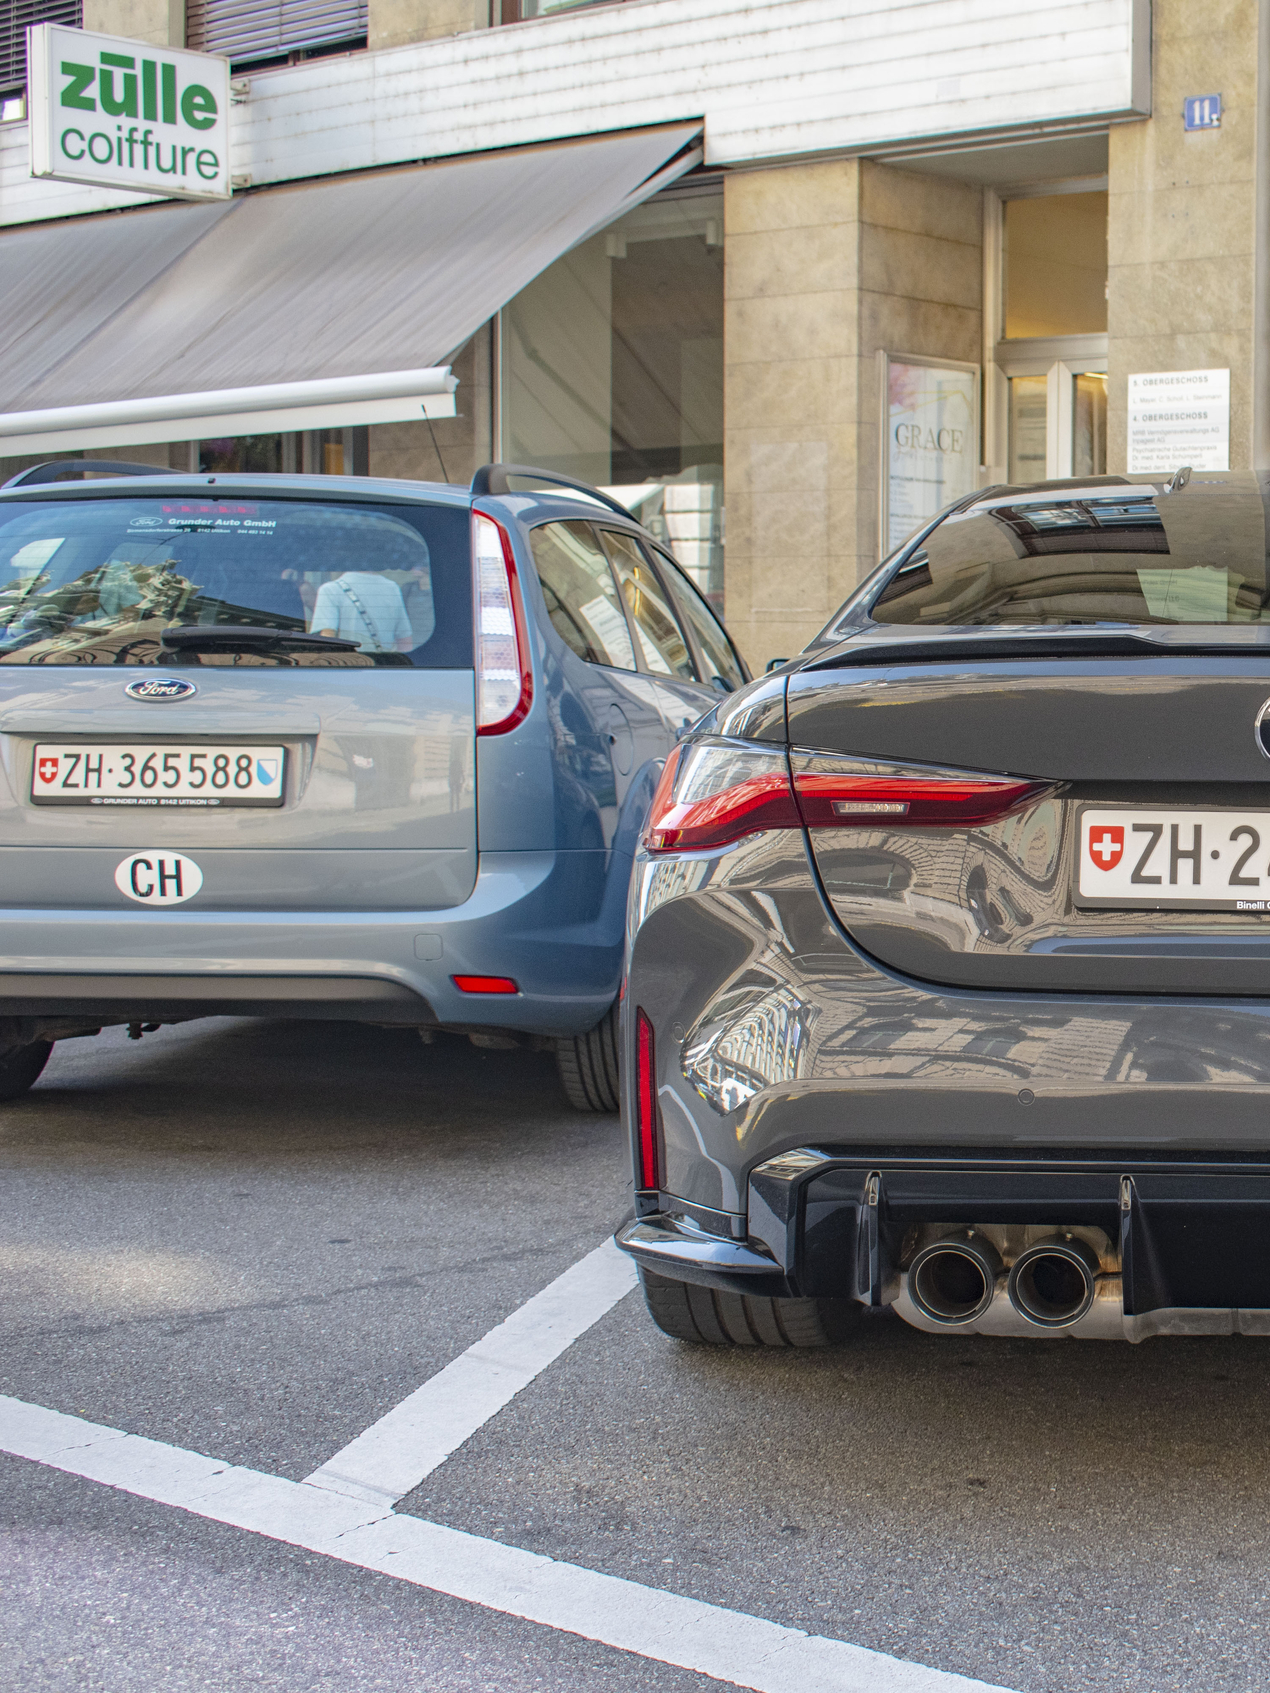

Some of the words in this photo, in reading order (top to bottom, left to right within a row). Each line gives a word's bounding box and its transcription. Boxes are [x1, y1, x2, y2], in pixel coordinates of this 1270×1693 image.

[61, 125, 219, 180] coiffure
[1143, 375, 1209, 386] OBERGESCHOSS
[1142, 411, 1209, 422] OBERGESCHOSS
[895, 423, 963, 454] GRACE
[168, 518, 213, 526] Grunder
[214, 519, 241, 527] Auto
[243, 519, 277, 528] GmbH
[139, 681, 179, 696] Ford
[130, 859, 184, 897] CH
[1236, 901, 1265, 910] Binelli
